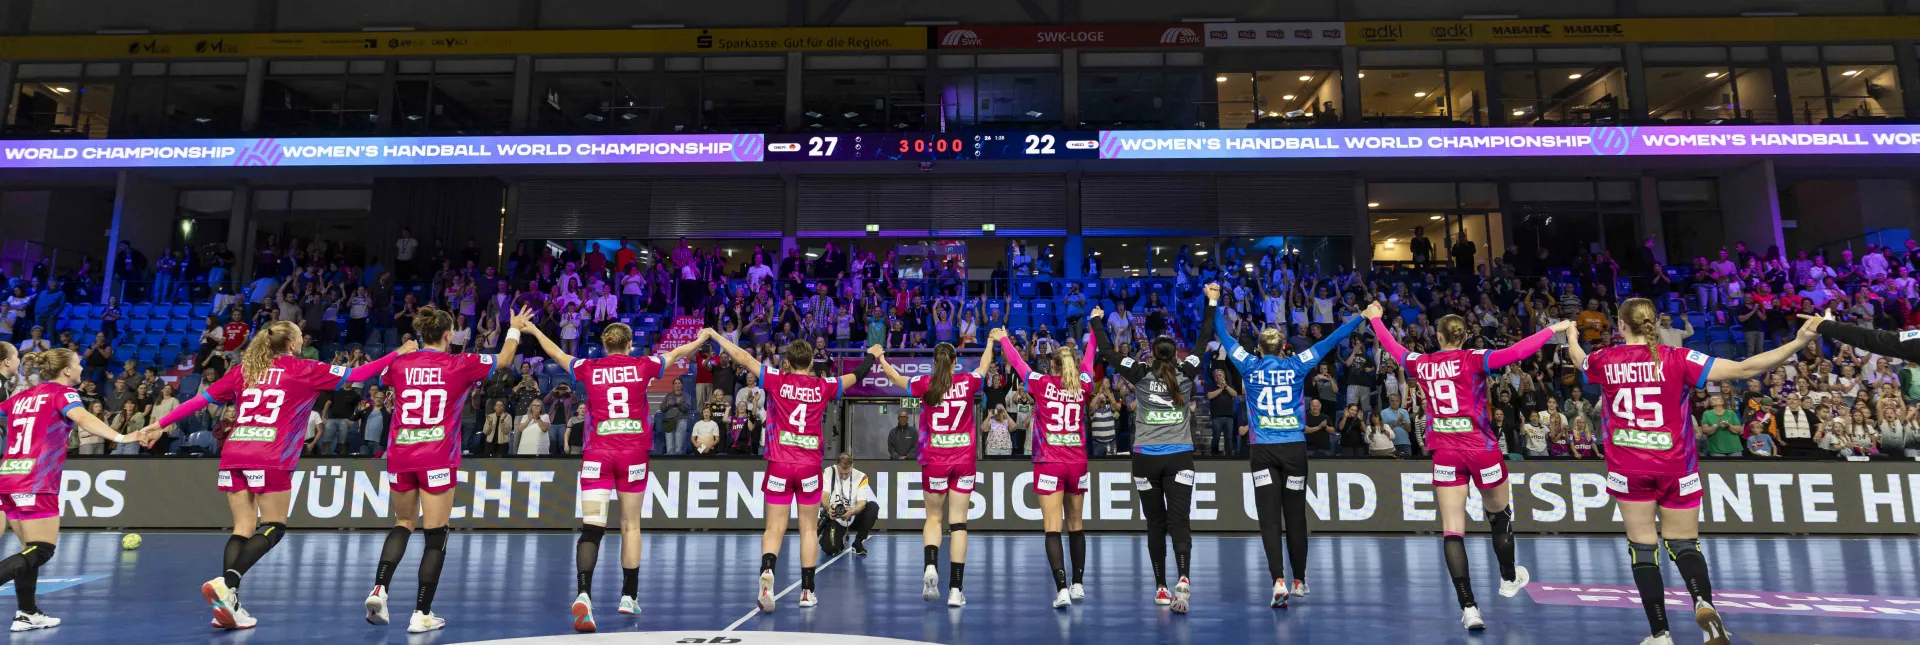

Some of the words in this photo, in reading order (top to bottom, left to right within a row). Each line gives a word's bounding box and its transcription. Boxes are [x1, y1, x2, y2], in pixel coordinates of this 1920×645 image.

[784, 37, 802, 48] Gut
[806, 36, 823, 47] für
[826, 36, 844, 47] die
[848, 37, 892, 48] Region.
[1037, 32, 1104, 42] SWK-LOGE
[1180, 36, 1200, 44] SWK
[808, 136, 838, 156] 27
[899, 139, 963, 153] 30:00
[1025, 134, 1056, 155] 22
[1121, 138, 1221, 150] WOMEN'S
[1225, 137, 1339, 150] HANDBALL
[1344, 136, 1423, 149] WORLD
[1428, 135, 1592, 149] CHAMPIONSHIP
[1642, 134, 1747, 147] WOMEN'S
[1751, 133, 1868, 146] HANDBALL
[5, 148, 77, 160] WORLD
[81, 146, 235, 159] CHAMPIONSHIP
[282, 145, 379, 158] WOMEN'S
[382, 144, 492, 157] HANDBALL
[496, 143, 572, 156] WORLD
[576, 142, 733, 155] CHAMPIONSHIP
[405, 367, 445, 385] VOGEL
[592, 365, 643, 385] ENGEL
[1250, 369, 1296, 386] FILTER
[606, 386, 630, 419] 8
[1257, 385, 1294, 417] 42
[1426, 380, 1460, 415] 19
[237, 388, 286, 424] 23
[401, 389, 447, 425] 20
[1612, 386, 1665, 428] 45
[788, 403, 808, 433] 4
[932, 400, 968, 431] 27
[1046, 401, 1081, 432] 30
[1147, 411, 1184, 421] ALSCO
[1260, 416, 1298, 425] ALSCO
[599, 420, 642, 432] ALSCO
[1433, 418, 1472, 429] ALSCO
[8, 417, 36, 454] 31
[230, 427, 276, 437] ALSCO
[397, 427, 444, 441] ALSCO
[780, 431, 818, 445] ALSCO
[932, 434, 969, 444] ALSCO
[1614, 429, 1671, 445] ALSCO
[428, 472, 450, 480] brother
[1434, 468, 1455, 476] brother
[1481, 468, 1501, 478] brother
[1680, 478, 1699, 488] brother
[59, 470, 127, 518] RS
[676, 636, 743, 644] ab
